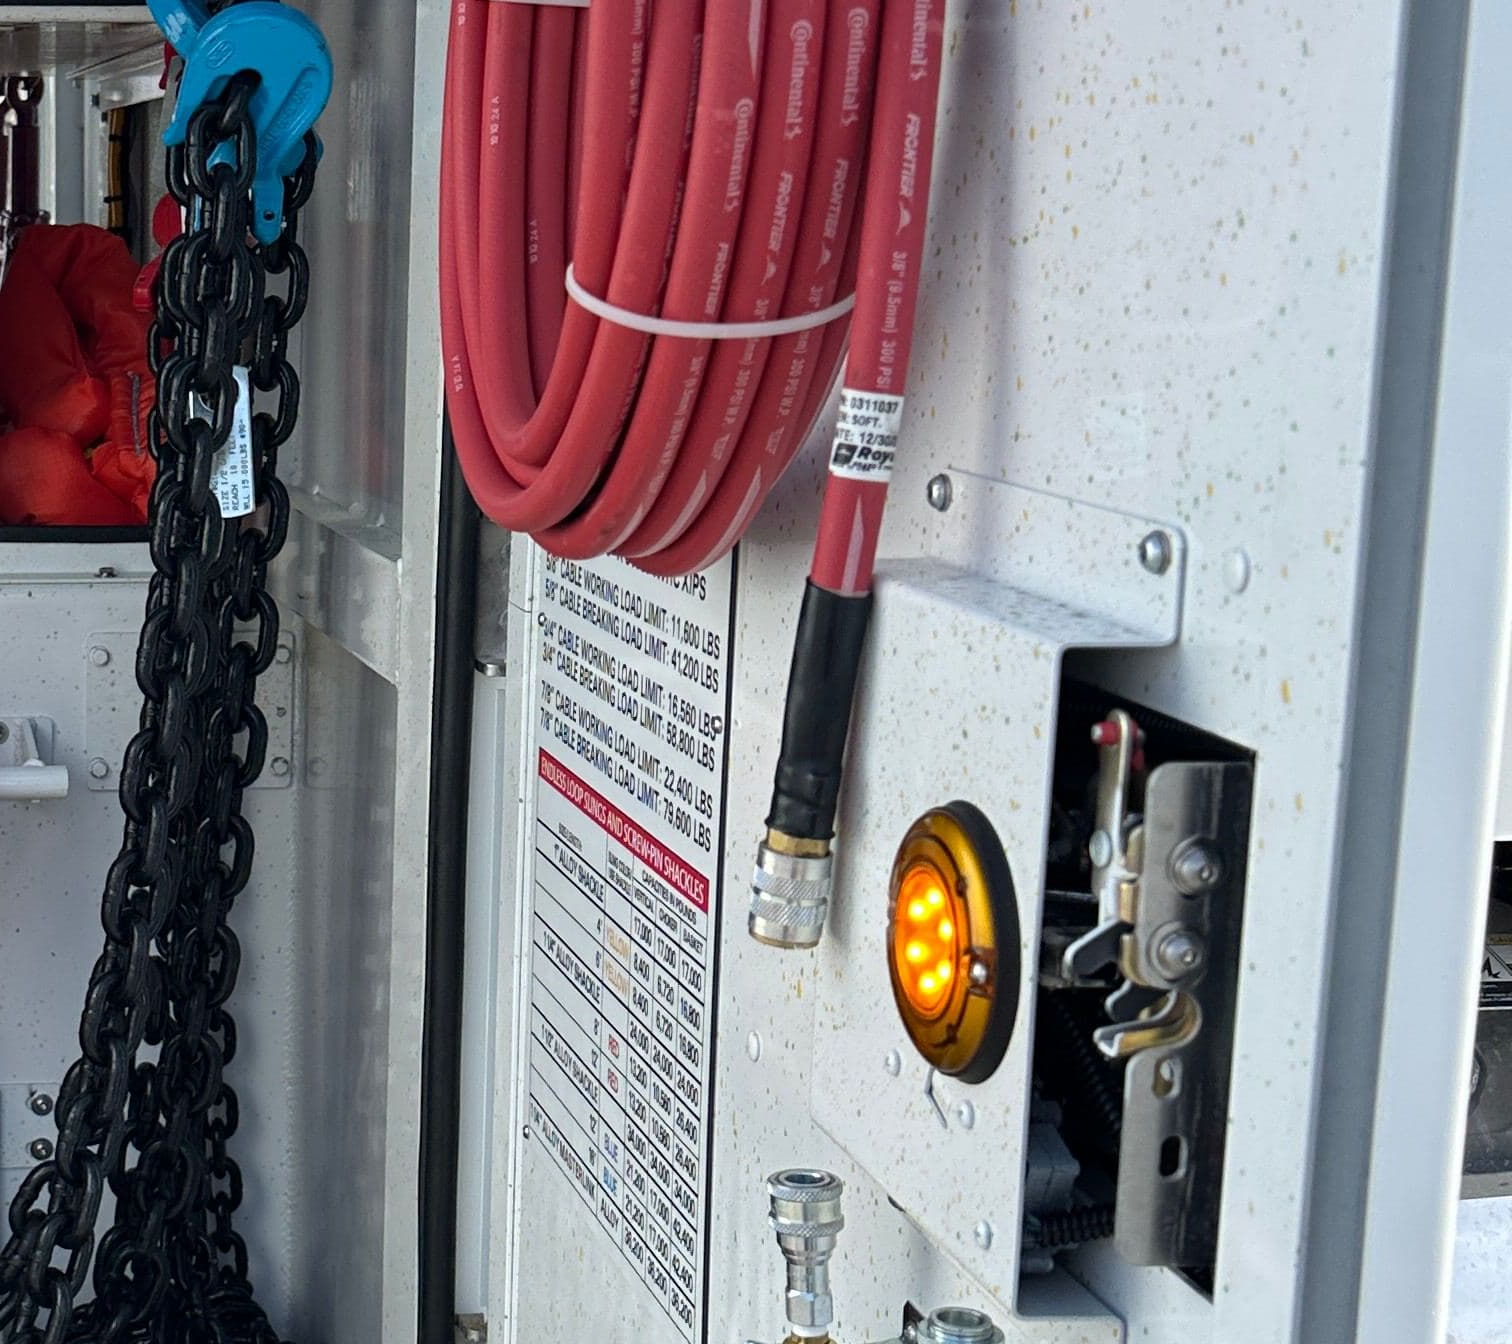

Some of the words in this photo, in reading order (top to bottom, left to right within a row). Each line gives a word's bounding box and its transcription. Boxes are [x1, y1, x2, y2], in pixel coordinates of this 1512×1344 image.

[785, 19, 813, 123] Continental
[841, 7, 870, 111] Continental
[725, 97, 755, 196] Continental
[823, 158, 849, 238] FRONTIER
[899, 113, 921, 198] FRONTIER
[767, 171, 794, 253] FRONTIER
[704, 241, 729, 317] FRONTIER
[874, 365, 893, 390] PSI
[879, 339, 897, 363] 300
[558, 583, 581, 617] CABLE
[581, 596, 619, 639] BREAKING
[620, 616, 642, 651] LOAD
[644, 628, 669, 666] LIMIT:
[670, 643, 699, 683] 41,200
[699, 658, 719, 694] LBS
[559, 556, 582, 588] CABLE
[583, 568, 619, 607] WORKING
[620, 586, 642, 620] LOAD
[643, 597, 669, 634] LIMIT:
[670, 611, 700, 650] 11,600
[701, 626, 720, 660] LBS
[556, 648, 578, 684] CABLE
[578, 663, 615, 708] BREAKING
[616, 686, 638, 723] LOAD
[639, 700, 665, 740] LIMIT:
[666, 717, 695, 760] 58,800
[696, 736, 715, 773] LBS
[557, 623, 579, 658] CABLE
[580, 637, 616, 680] WORKING
[617, 658, 639, 694] LOAD
[640, 672, 666, 711] LIMIT:
[667, 688, 697, 730] 16,560
[553, 716, 576, 753] CABLE
[576, 732, 613, 781] BREAKING
[614, 759, 636, 798] LOAD
[636, 775, 662, 817] LIMIT:
[662, 794, 692, 840] 79,600
[693, 816, 711, 854] LBS
[554, 688, 577, 725] CABLE
[577, 703, 613, 750] WORKING
[614, 728, 636, 766] LOAD
[637, 744, 662, 785] LIMIT:
[663, 762, 693, 807] 22,400
[694, 783, 713, 821] LBS
[540, 755, 566, 794] ENDLESS
[566, 775, 583, 808] LOOP
[583, 789, 606, 827] SLINGS
[606, 807, 623, 841] AND
[623, 820, 663, 874] SCREW-PIN
[663, 852, 704, 907] SHACKLES
[558, 845, 577, 879] ALLOY
[577, 863, 604, 904] SHACKLE
[680, 956, 702, 994] 17,000
[633, 884, 654, 915] VERTICAL
[682, 926, 704, 958] BASKET
[555, 942, 574, 977] ALLOY
[573, 961, 600, 1006] SHACKLE
[676, 1068, 699, 1110] 24,000
[607, 1030, 620, 1061] RED
[553, 1035, 572, 1074] ALLOY
[571, 1057, 598, 1105] SHACKLE
[673, 1177, 695, 1222] 34,000
[606, 1064, 618, 1095] RED
[541, 1116, 559, 1154] ALLOY
[558, 1138, 595, 1203] MASTERLINK
[600, 1193, 619, 1234] ALLOY
[602, 1163, 617, 1199] BLUE
[603, 1130, 618, 1165] BLUE
